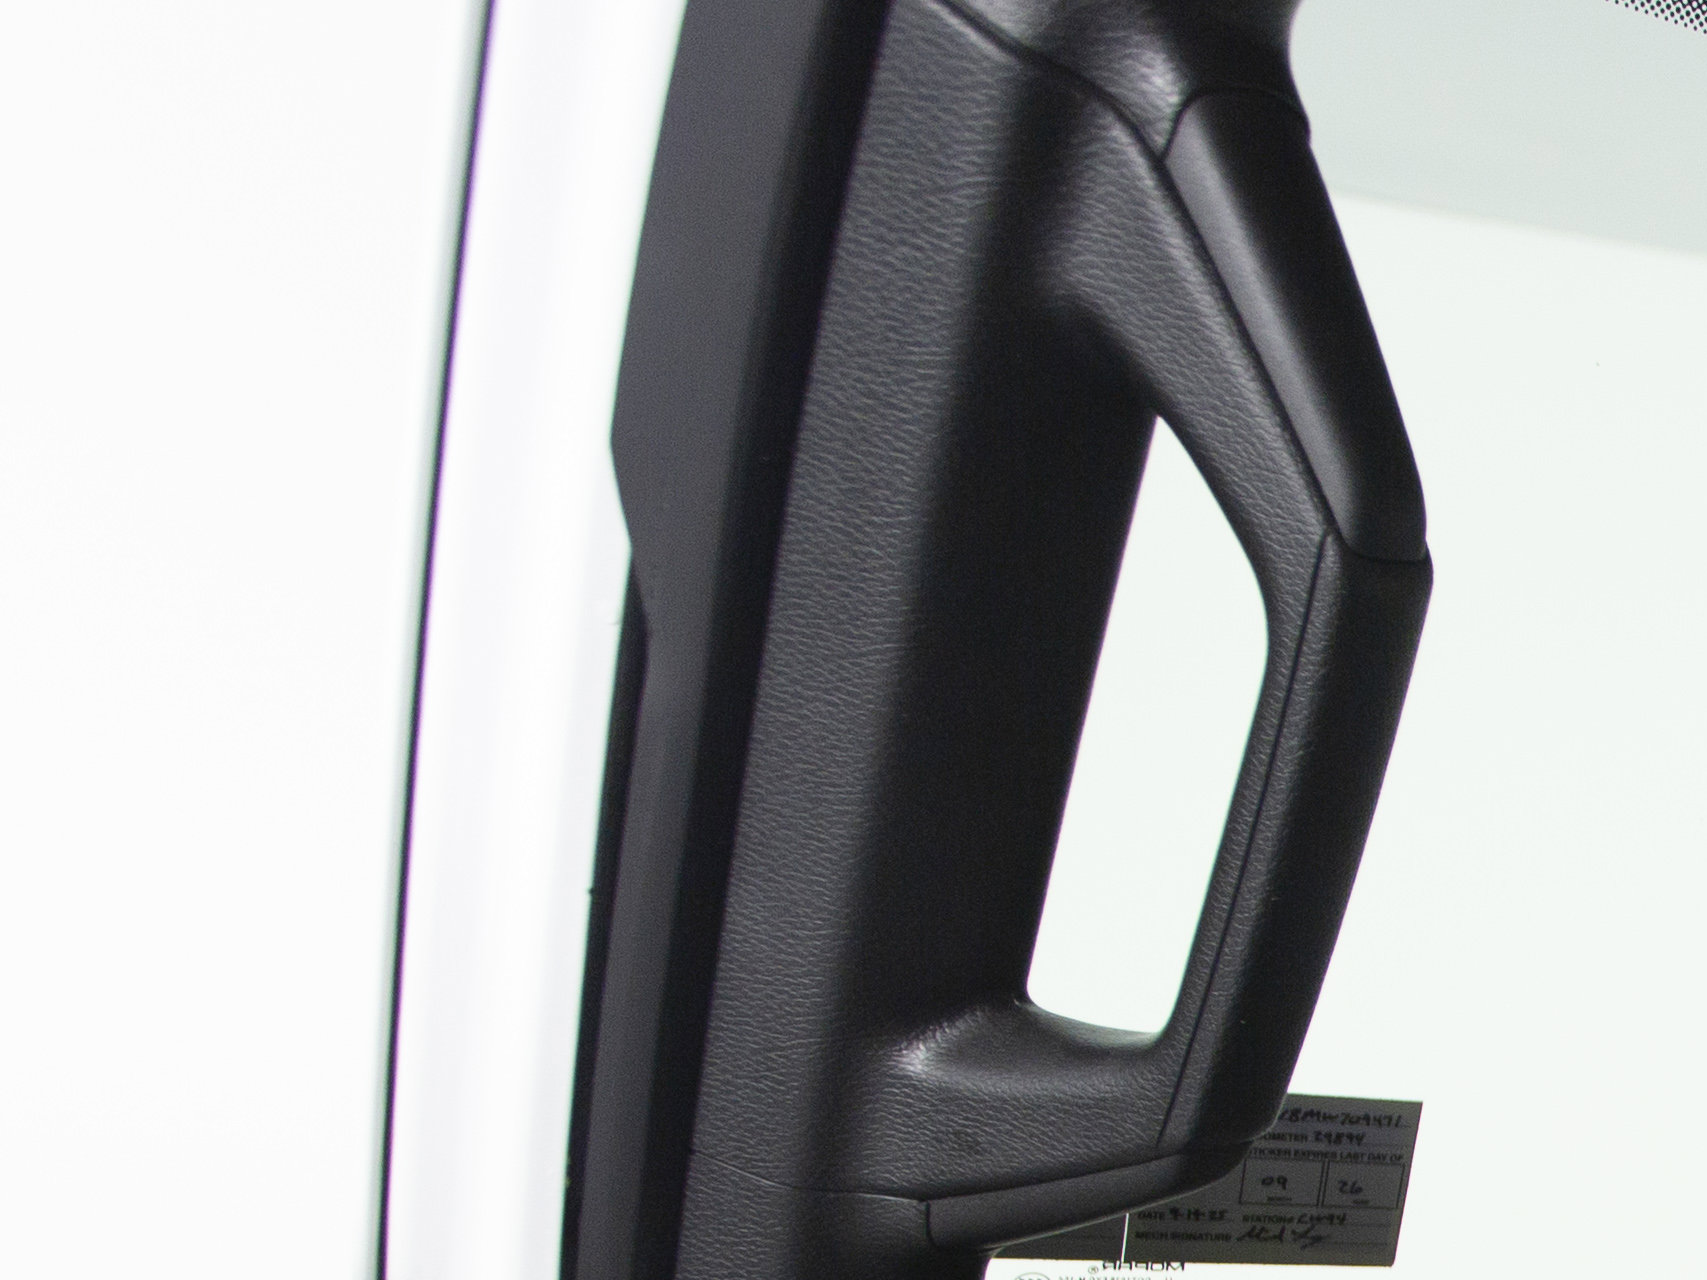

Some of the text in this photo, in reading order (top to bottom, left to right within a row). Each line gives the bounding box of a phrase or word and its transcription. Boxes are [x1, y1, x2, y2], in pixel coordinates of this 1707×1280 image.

[1251, 1147, 1405, 1162] TICKER EXPIRES LAST DAY OF
[1261, 1175, 1288, 1190] 09
[1138, 1210, 1165, 1220] DATE
